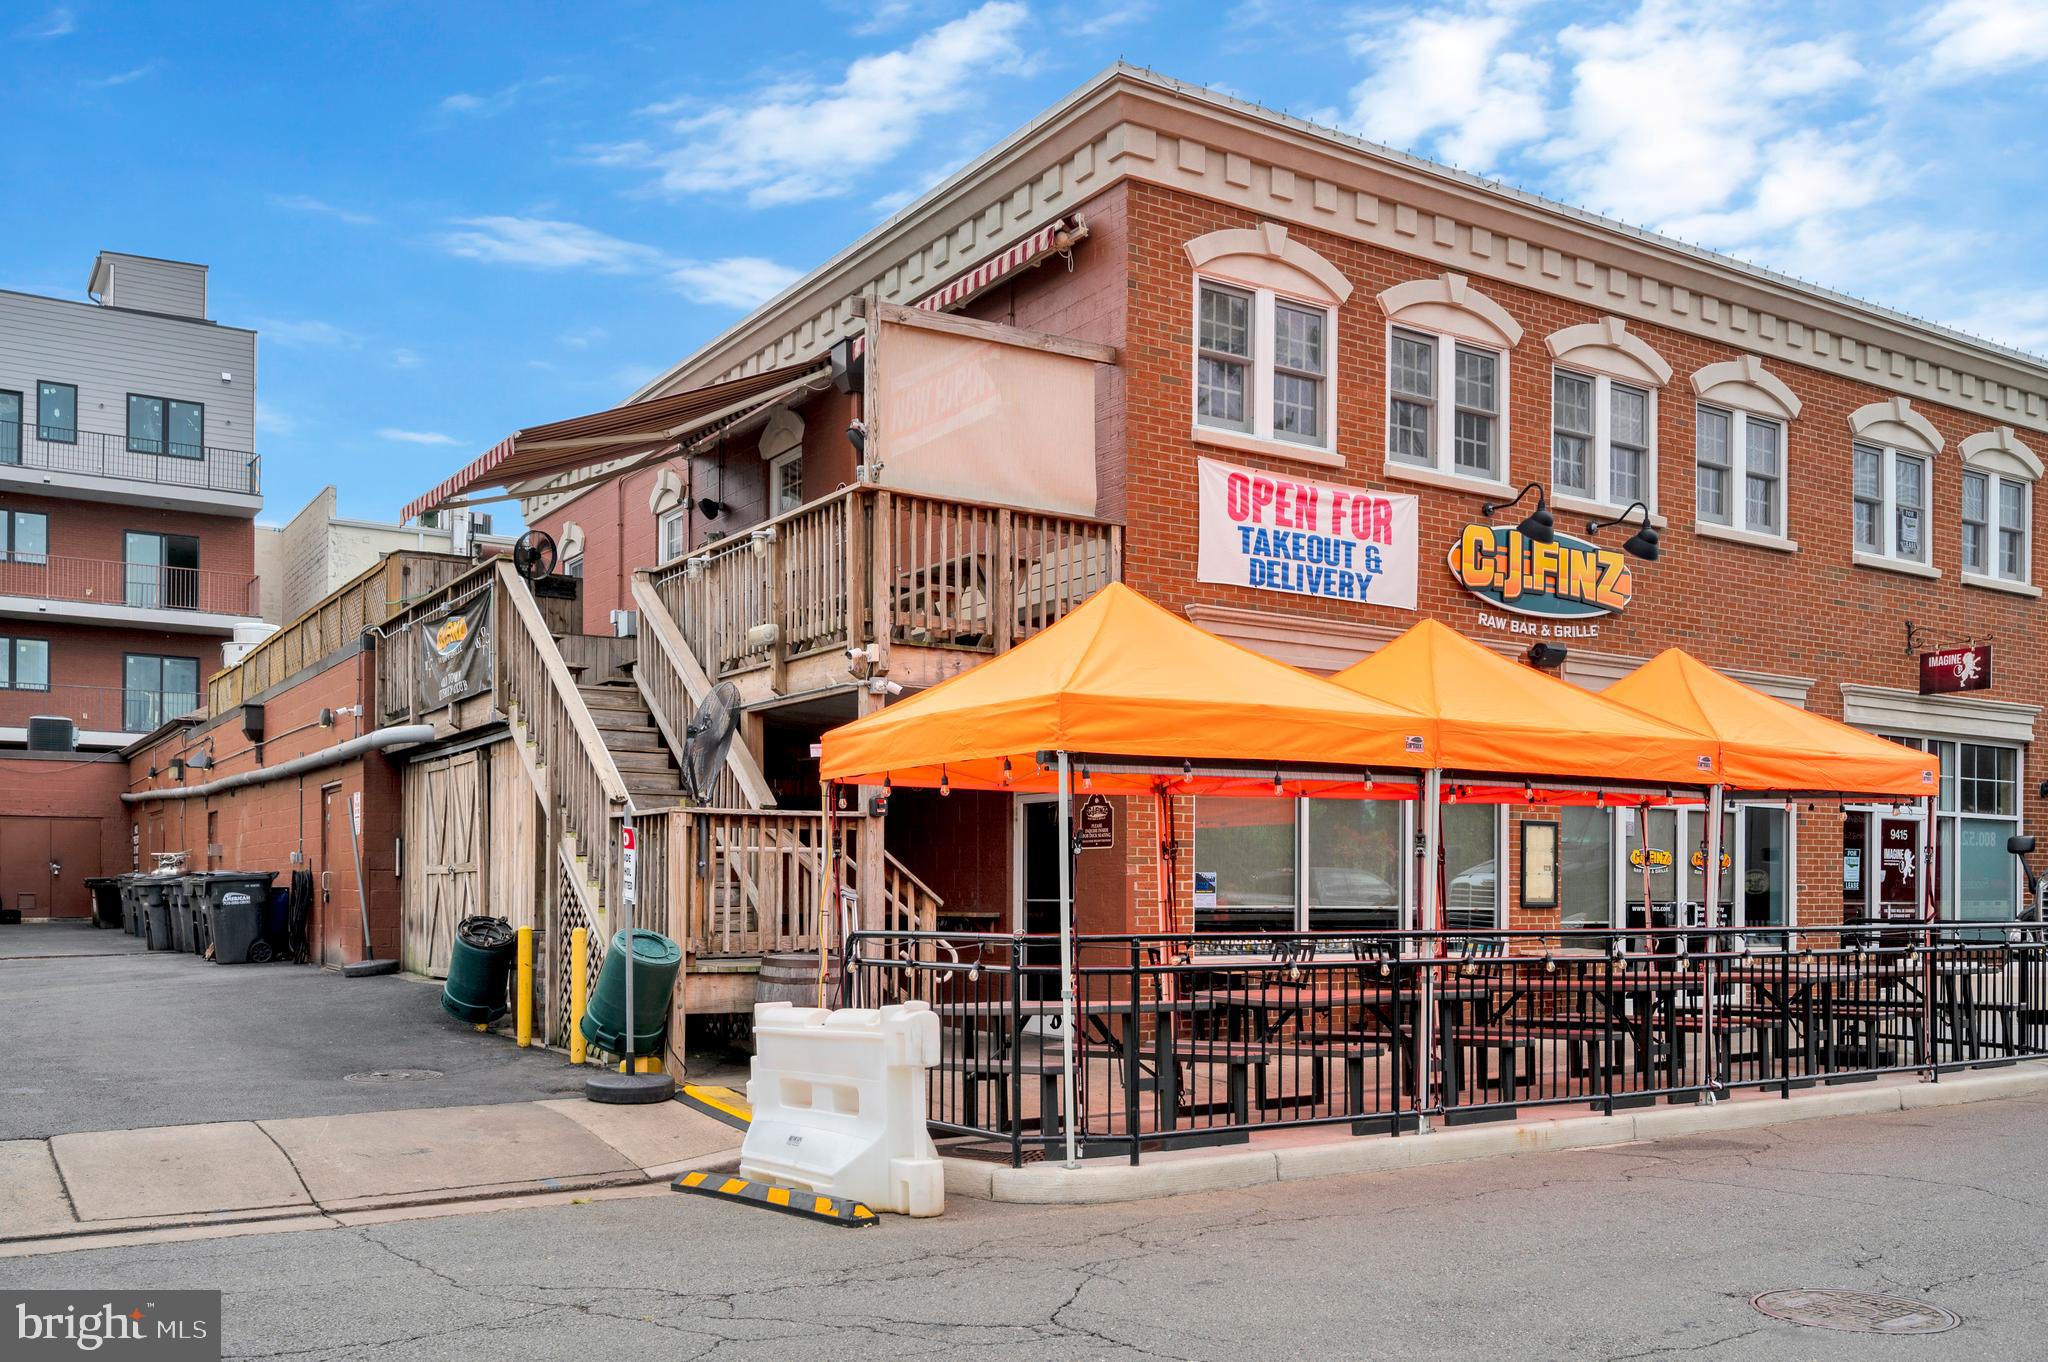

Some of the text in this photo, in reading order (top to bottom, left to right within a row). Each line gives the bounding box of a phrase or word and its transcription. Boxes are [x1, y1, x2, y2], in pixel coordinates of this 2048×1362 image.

[1227, 472, 1393, 545] OPEN FOR
[1237, 525, 1383, 575] TAKEOUT &
[1249, 557, 1373, 601] DELIVERY
[1478, 613, 1599, 638] RAW BAR & GRILLE
[1928, 653, 1962, 668] IMAGINE
[1890, 828, 1908, 840] 9415
[1883, 848, 1905, 860] IMAGINE
[1845, 881, 1860, 889] LEASE
